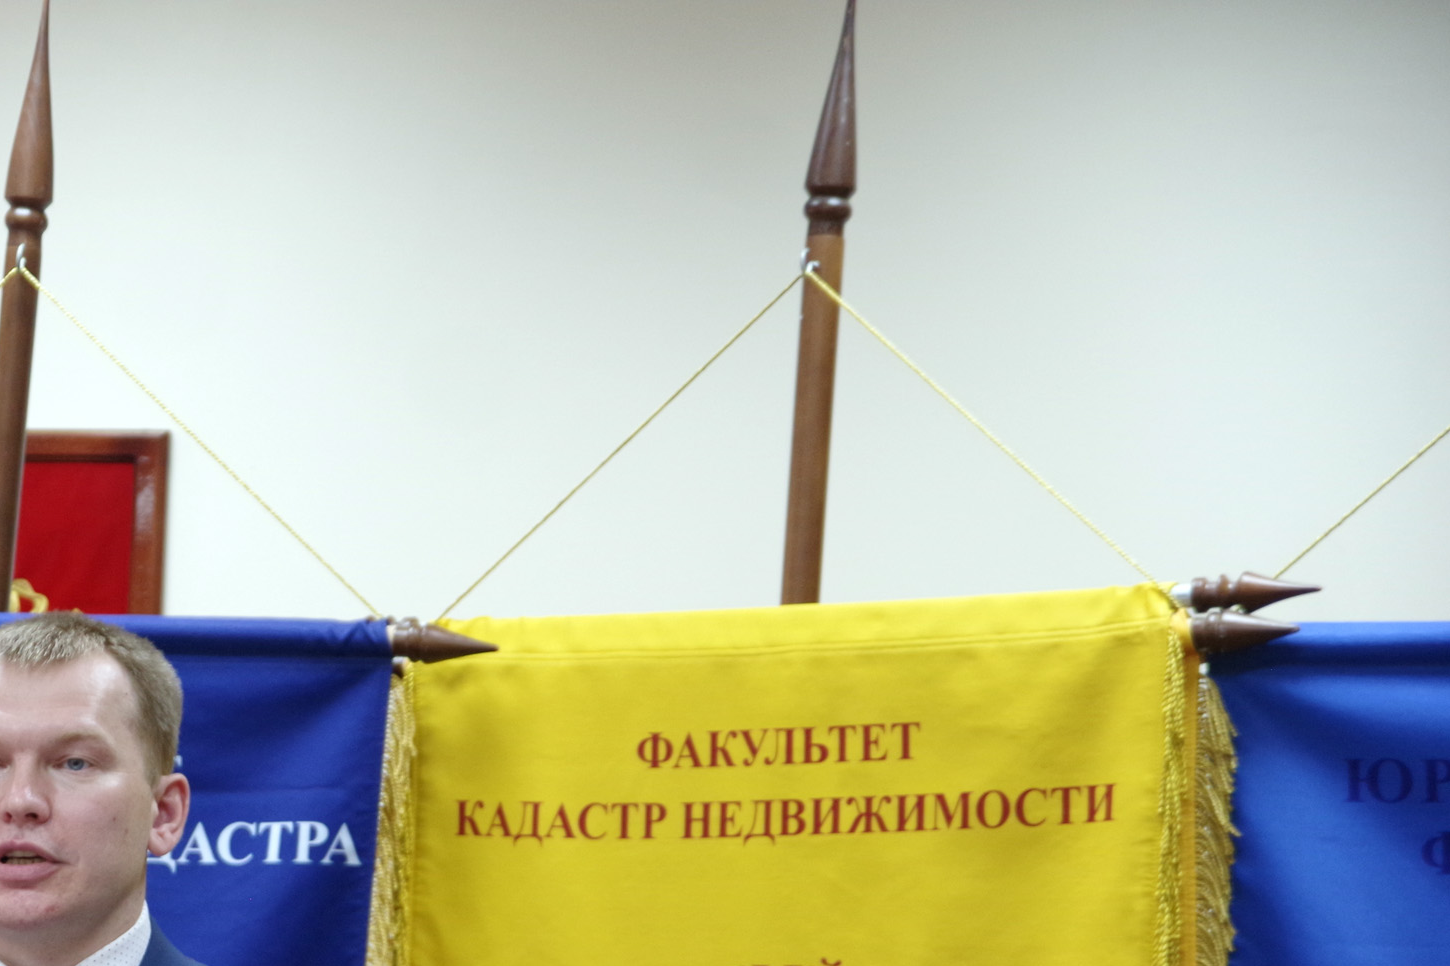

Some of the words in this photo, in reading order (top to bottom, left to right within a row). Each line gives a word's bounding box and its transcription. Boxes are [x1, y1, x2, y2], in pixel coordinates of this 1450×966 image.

[636, 721, 921, 769] ФАКУЛЬТЕТ
[455, 798, 668, 846] КАДАСТР
[682, 783, 1117, 846] НЕДВИЖИМОСТИ
